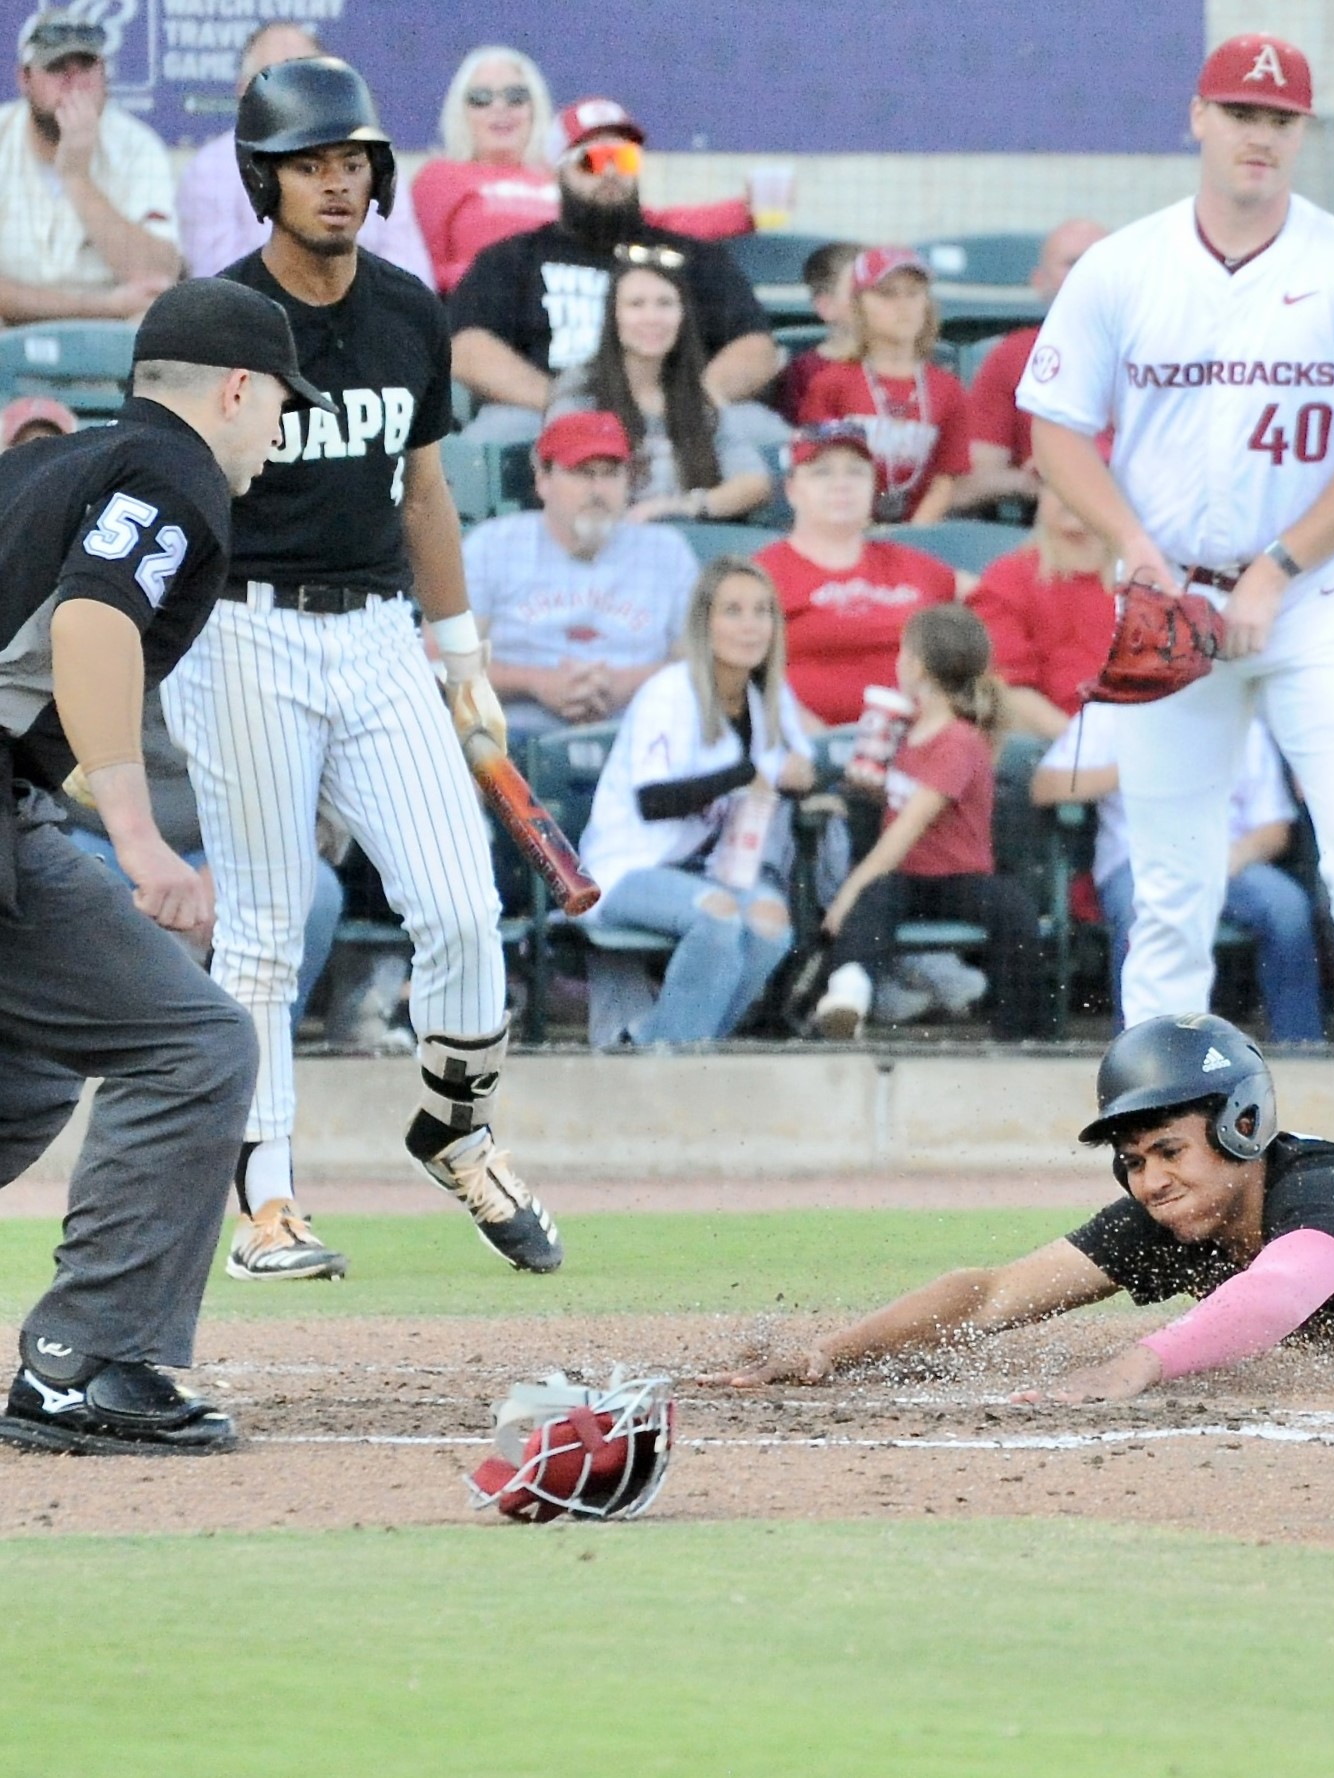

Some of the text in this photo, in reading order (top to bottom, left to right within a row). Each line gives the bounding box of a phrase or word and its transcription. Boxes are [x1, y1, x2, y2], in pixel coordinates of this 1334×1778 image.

[1243, 44, 1288, 87] A
[1249, 402, 1333, 466] 40
[83, 492, 188, 608] 52
